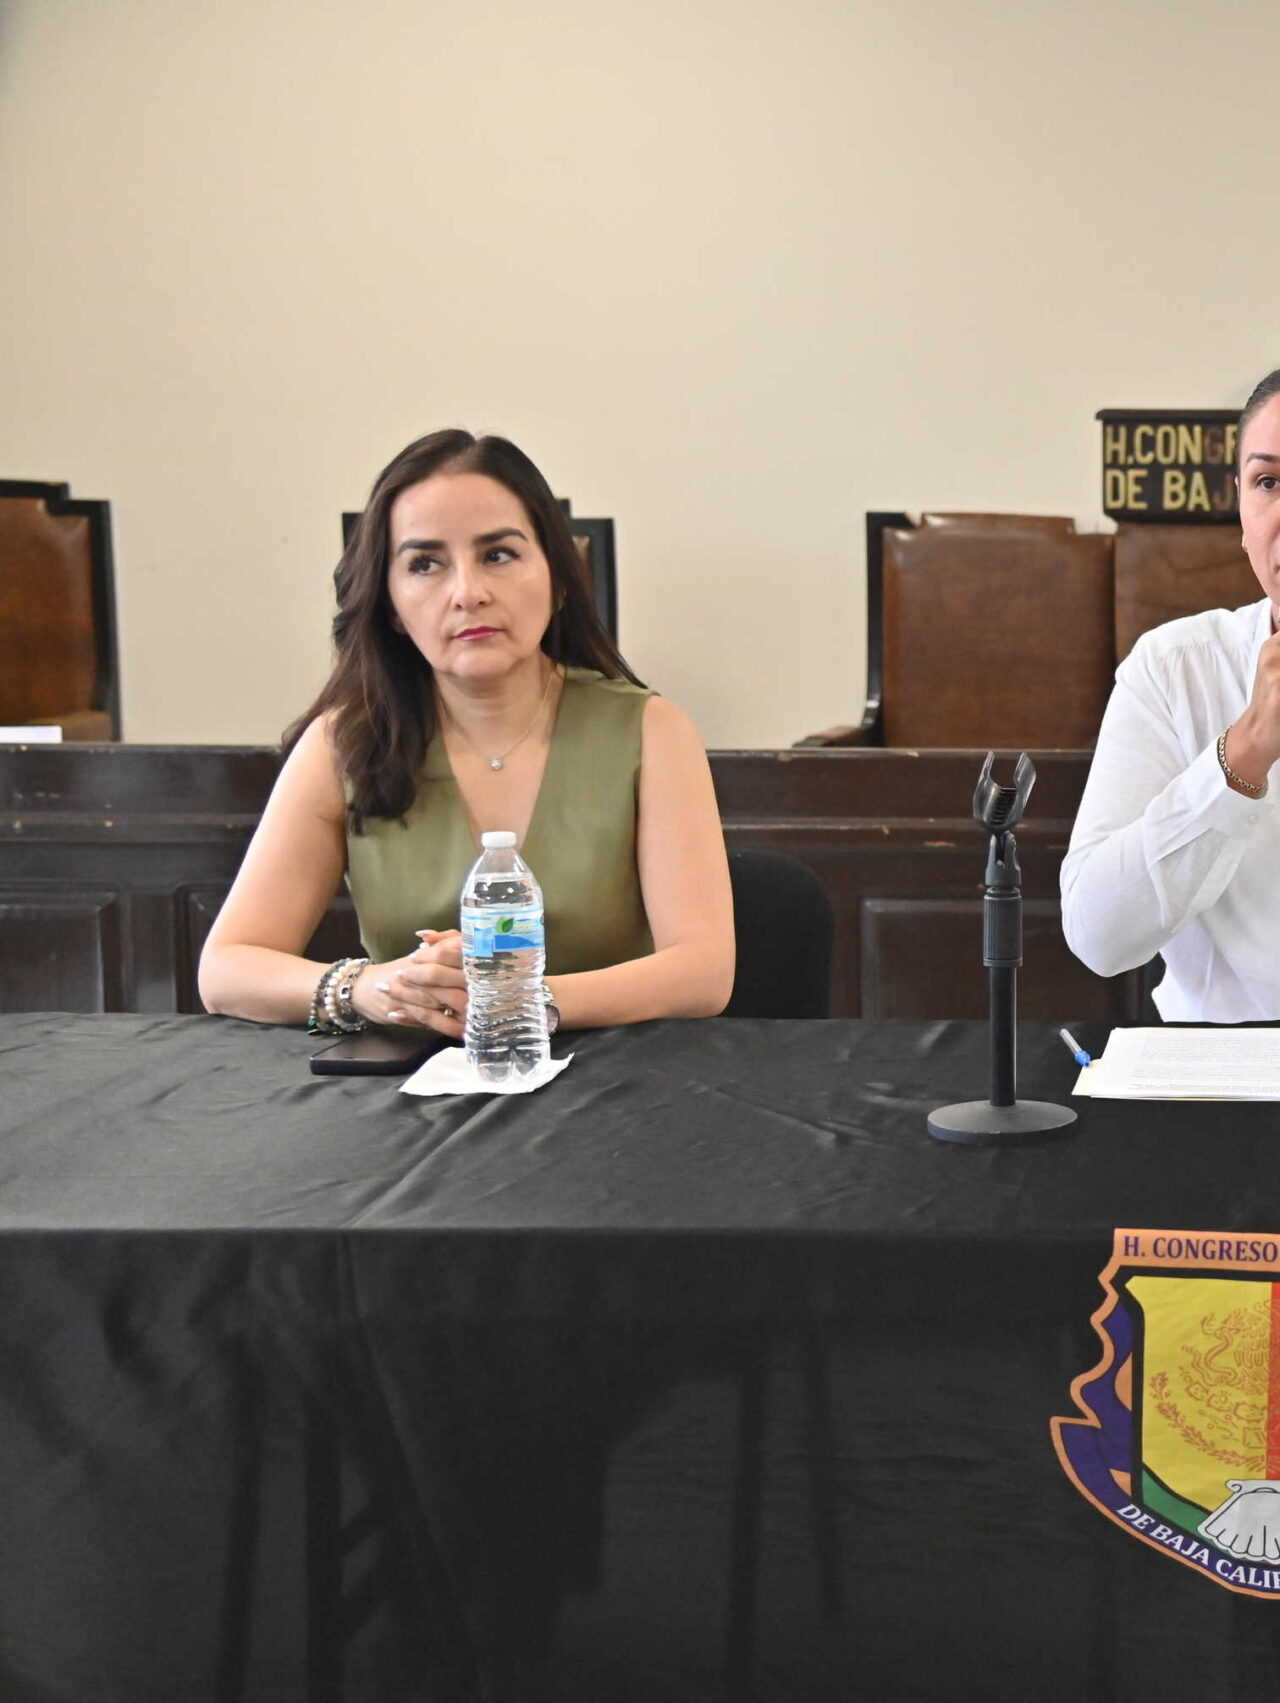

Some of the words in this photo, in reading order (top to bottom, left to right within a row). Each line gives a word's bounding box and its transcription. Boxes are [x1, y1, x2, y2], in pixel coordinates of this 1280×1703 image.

[1104, 423, 1238, 466] H.CONGR
[1105, 468, 1149, 511] DE
[1162, 469, 1235, 512] BAJ
[1123, 1235, 1147, 1258] H.
[1152, 1237, 1279, 1263] CONGRESO
[1116, 1503, 1156, 1530] DE
[1150, 1524, 1211, 1566] BAJA
